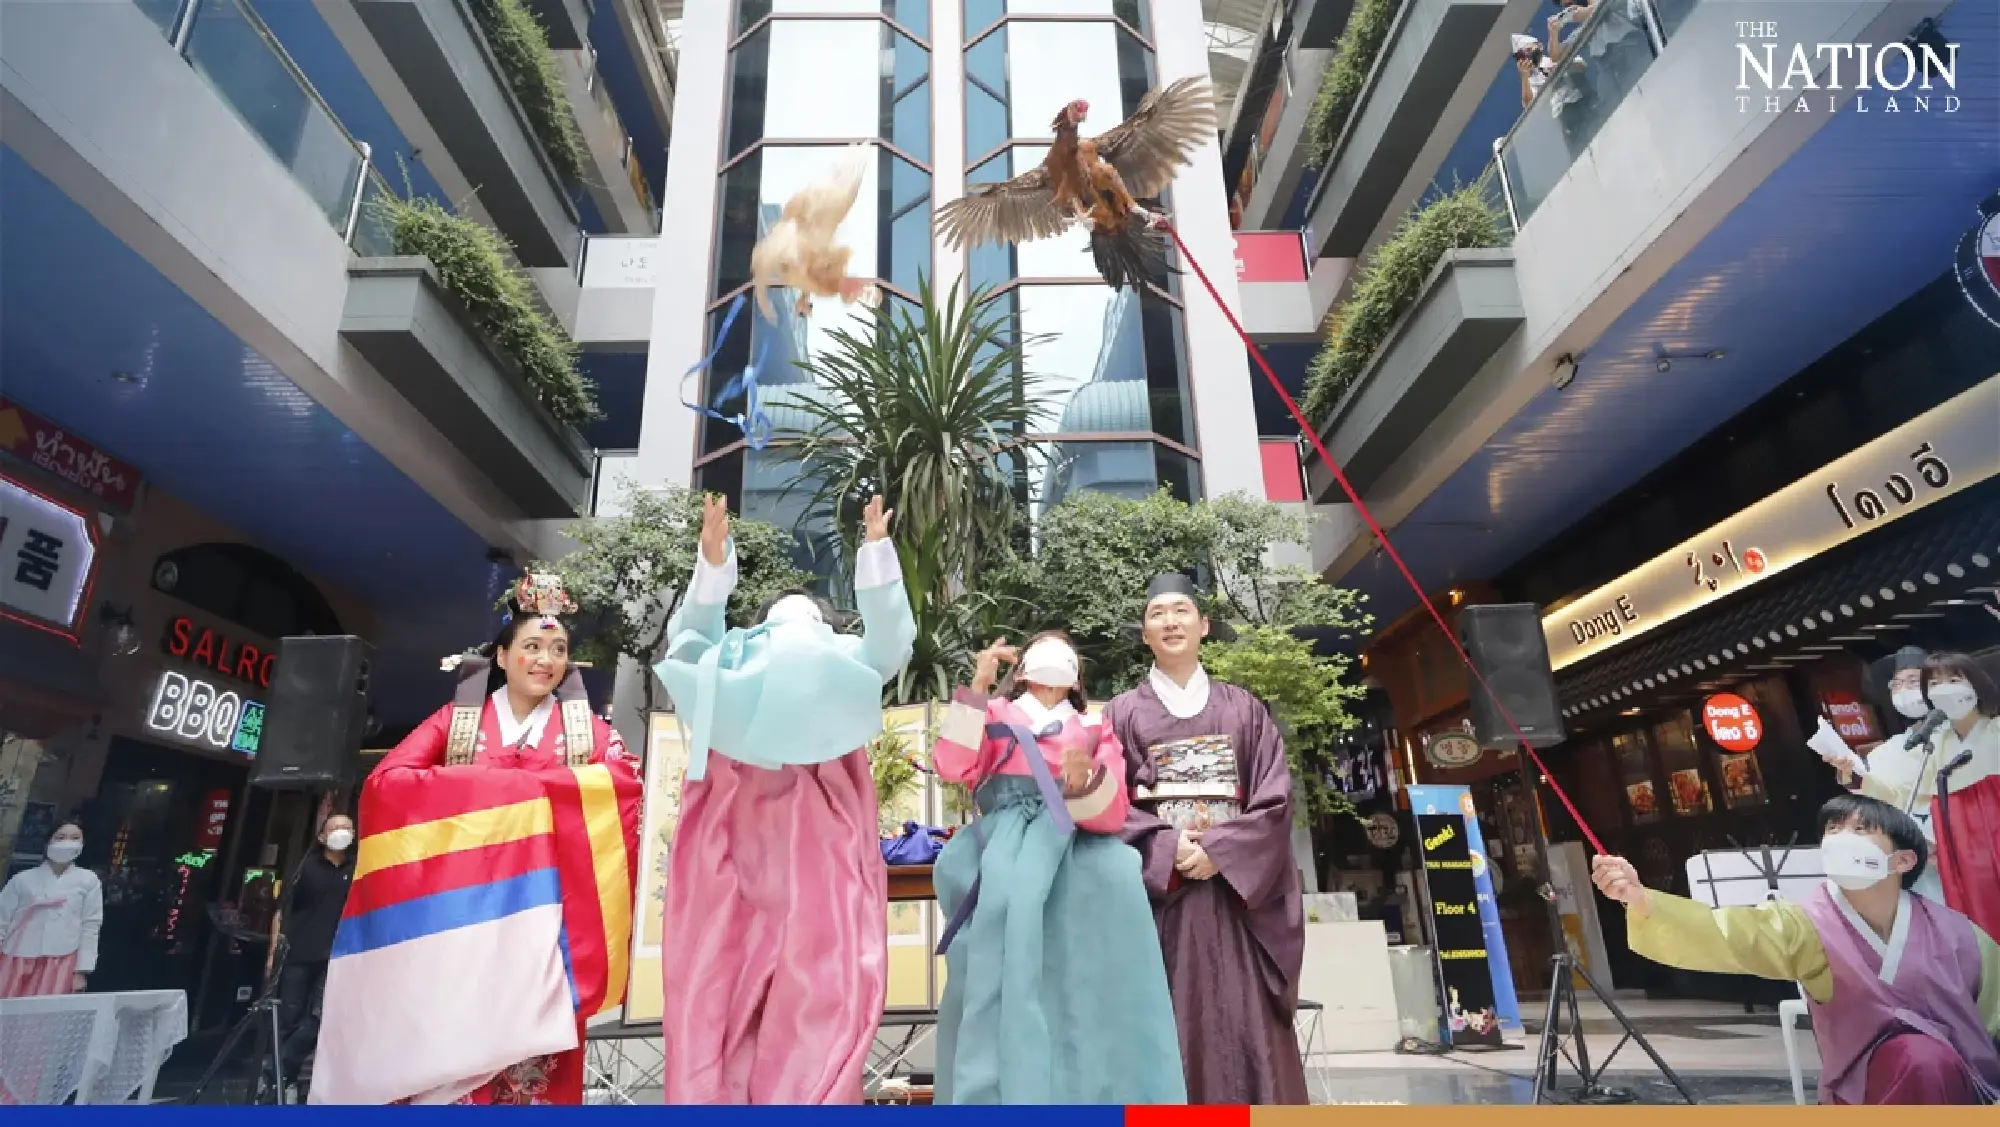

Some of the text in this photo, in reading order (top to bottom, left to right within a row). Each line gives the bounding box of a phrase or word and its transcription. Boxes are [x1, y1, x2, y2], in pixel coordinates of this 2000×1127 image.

[1569, 593, 1639, 645] Dong E
[148, 670, 241, 748] BBQ
[1706, 703, 1753, 719] Dong E
[1434, 901, 1477, 915] Floor 4
